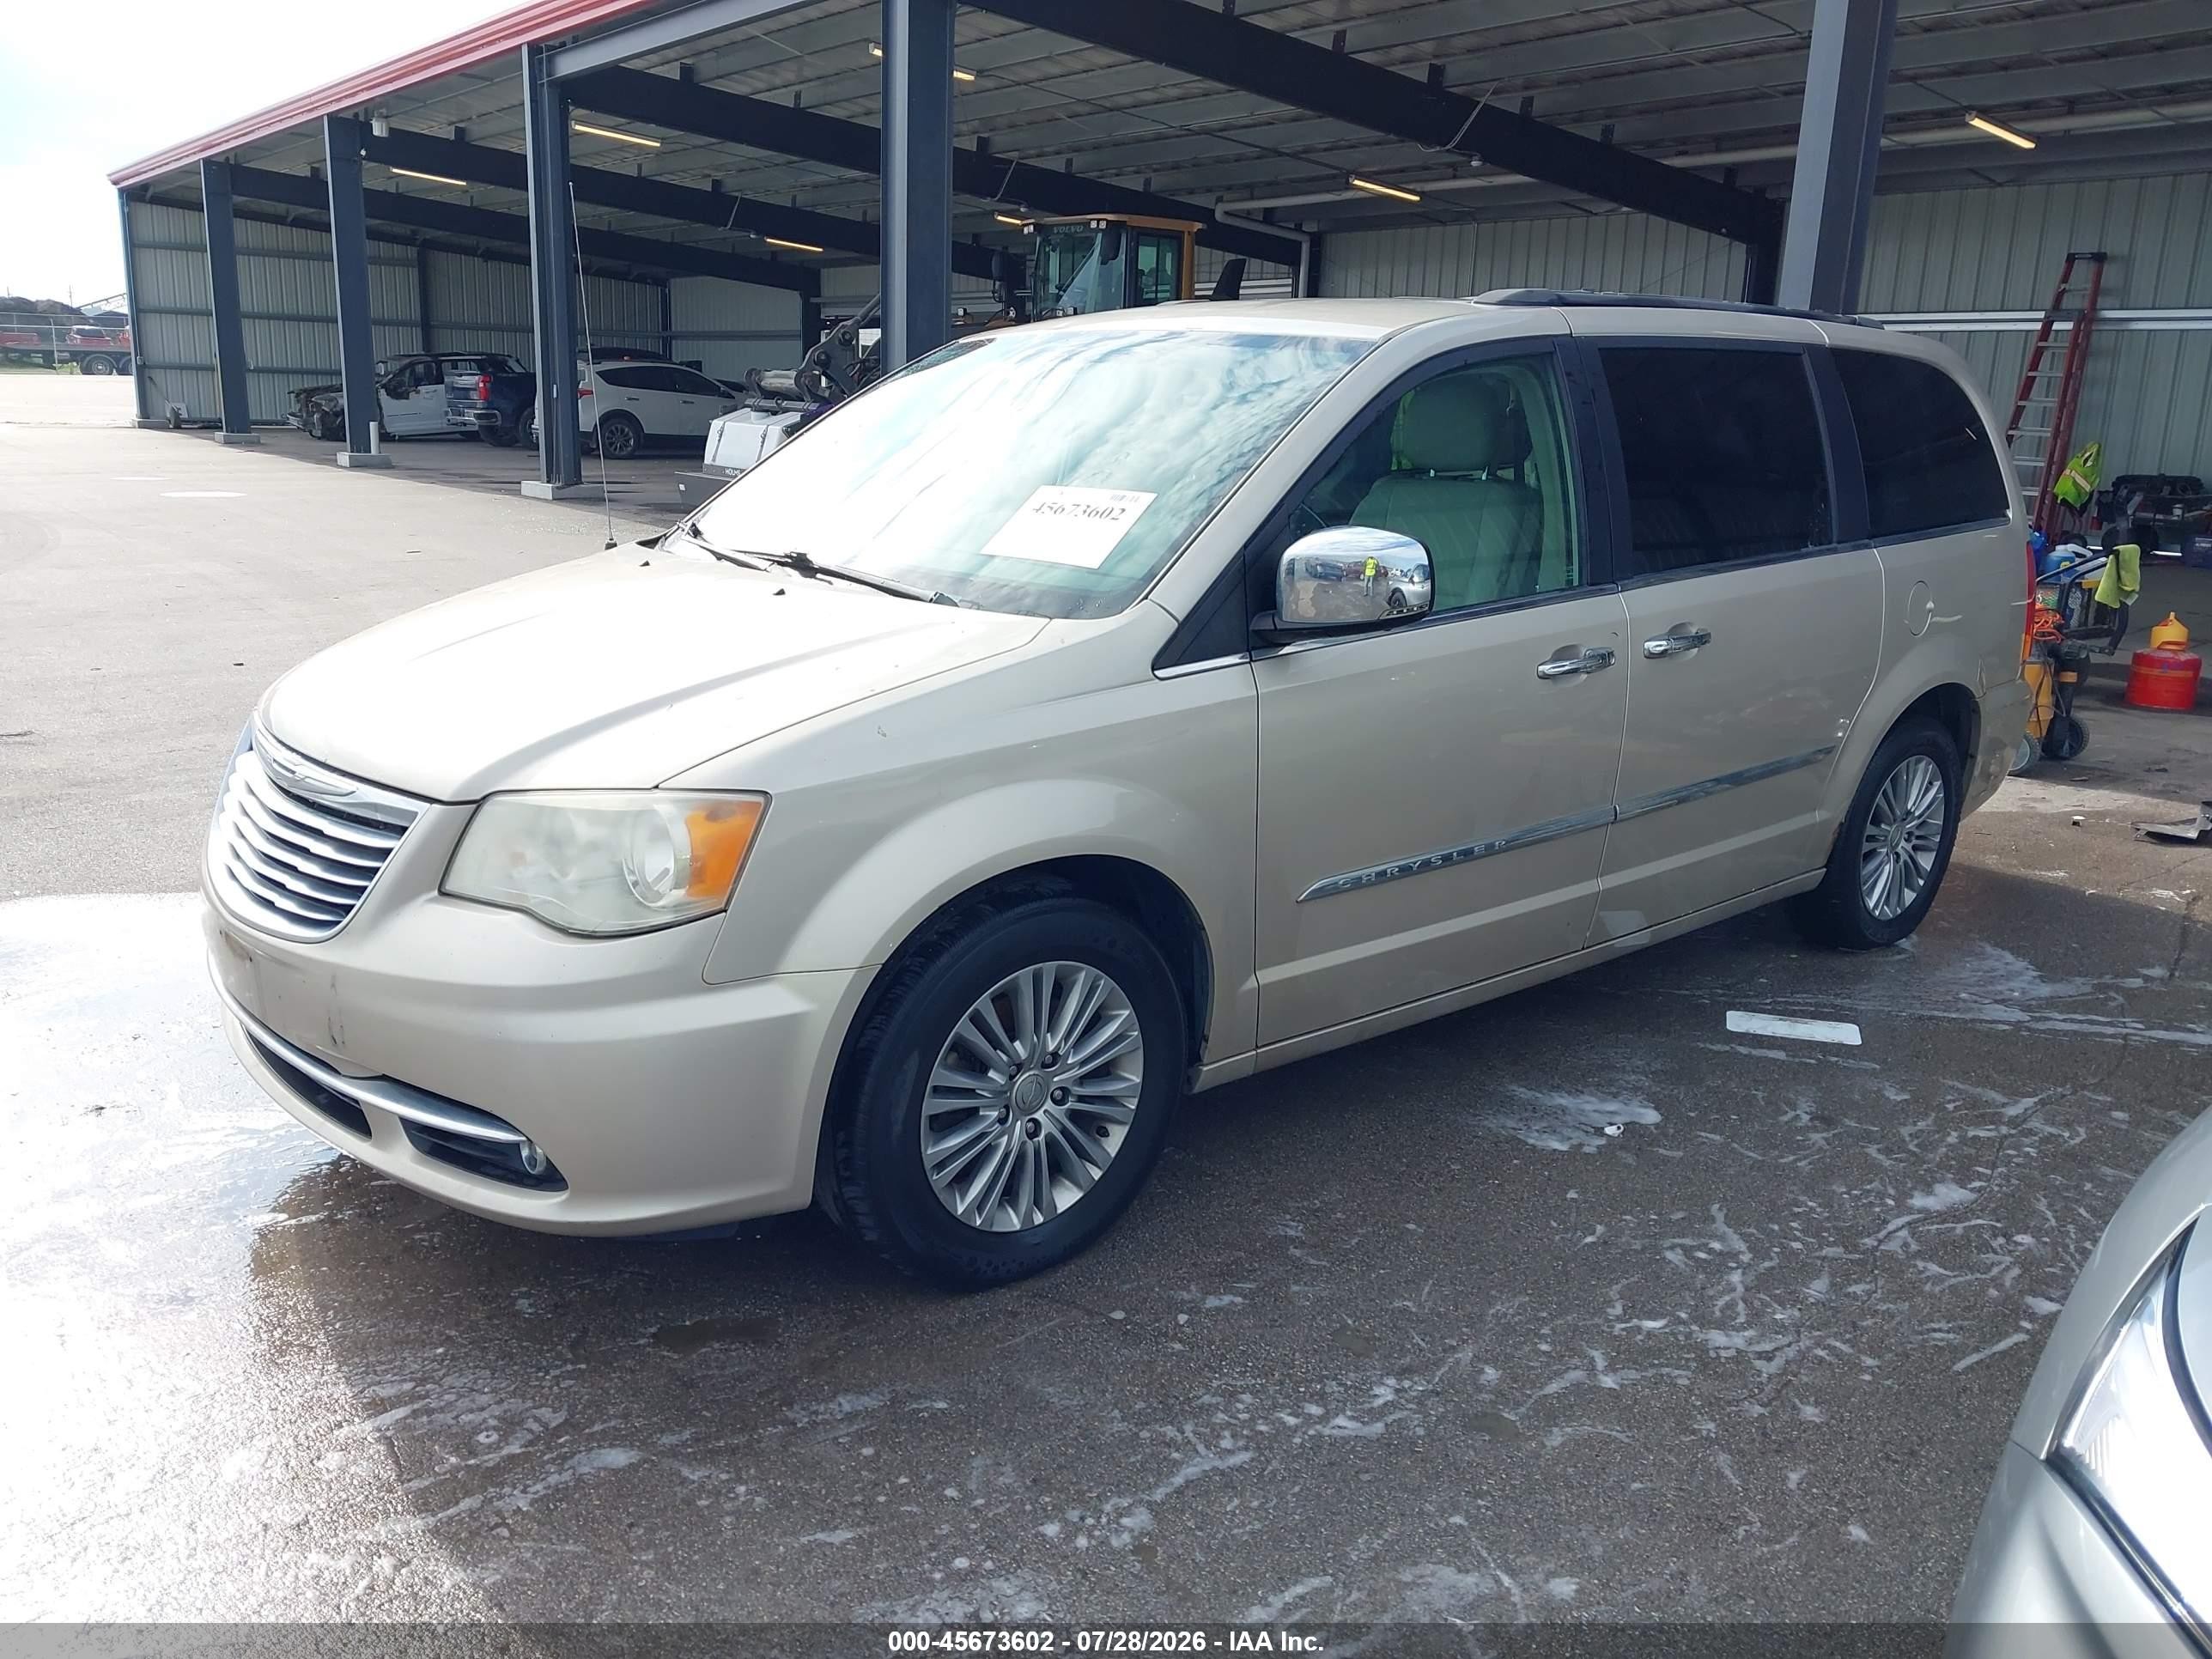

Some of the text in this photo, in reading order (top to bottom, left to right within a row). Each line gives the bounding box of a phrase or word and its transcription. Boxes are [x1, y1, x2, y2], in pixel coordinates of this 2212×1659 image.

[1054, 224, 1084, 234] VOLVO
[1032, 501, 1127, 520] 45673602
[1338, 840, 1507, 888] CHRYSLER
